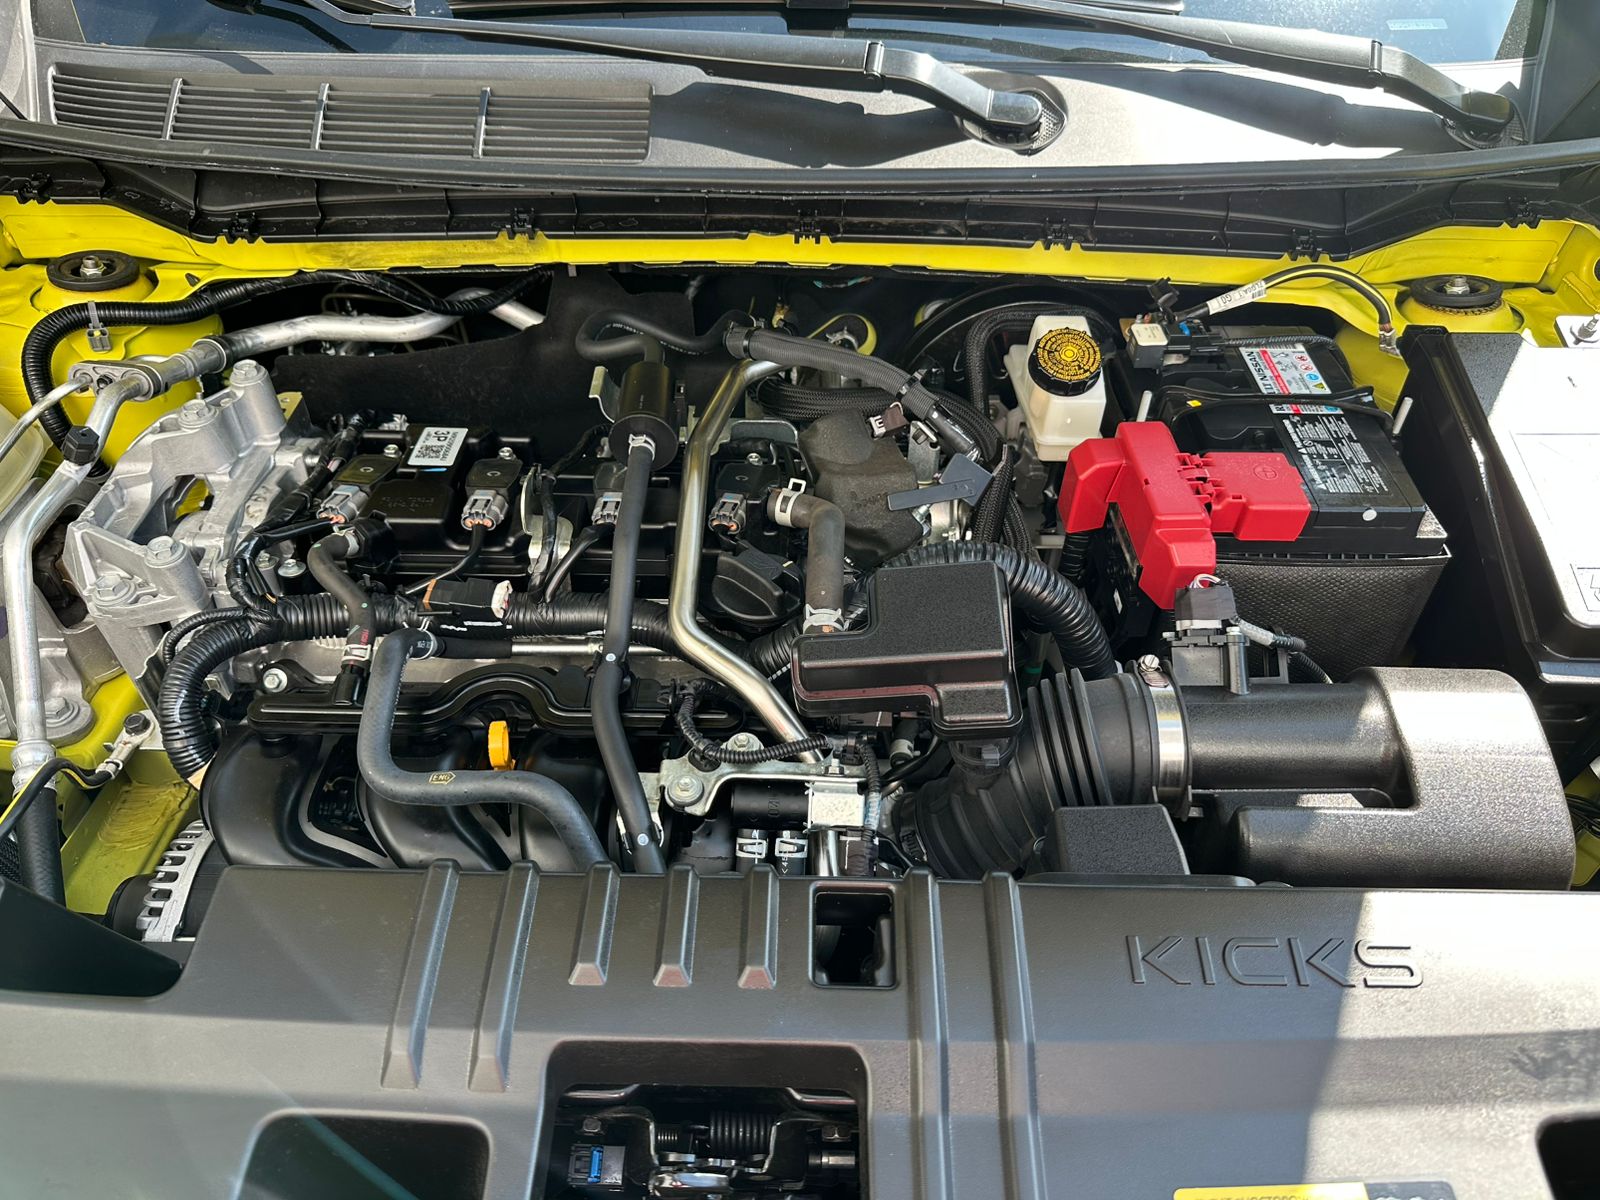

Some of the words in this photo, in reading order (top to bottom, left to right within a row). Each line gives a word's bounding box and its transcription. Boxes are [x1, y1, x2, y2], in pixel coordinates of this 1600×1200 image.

[1245, 351, 1268, 382] NISSAN
[432, 430, 450, 442] 3P
[432, 773, 451, 781] ENG
[1125, 936, 1423, 988] KICKS
